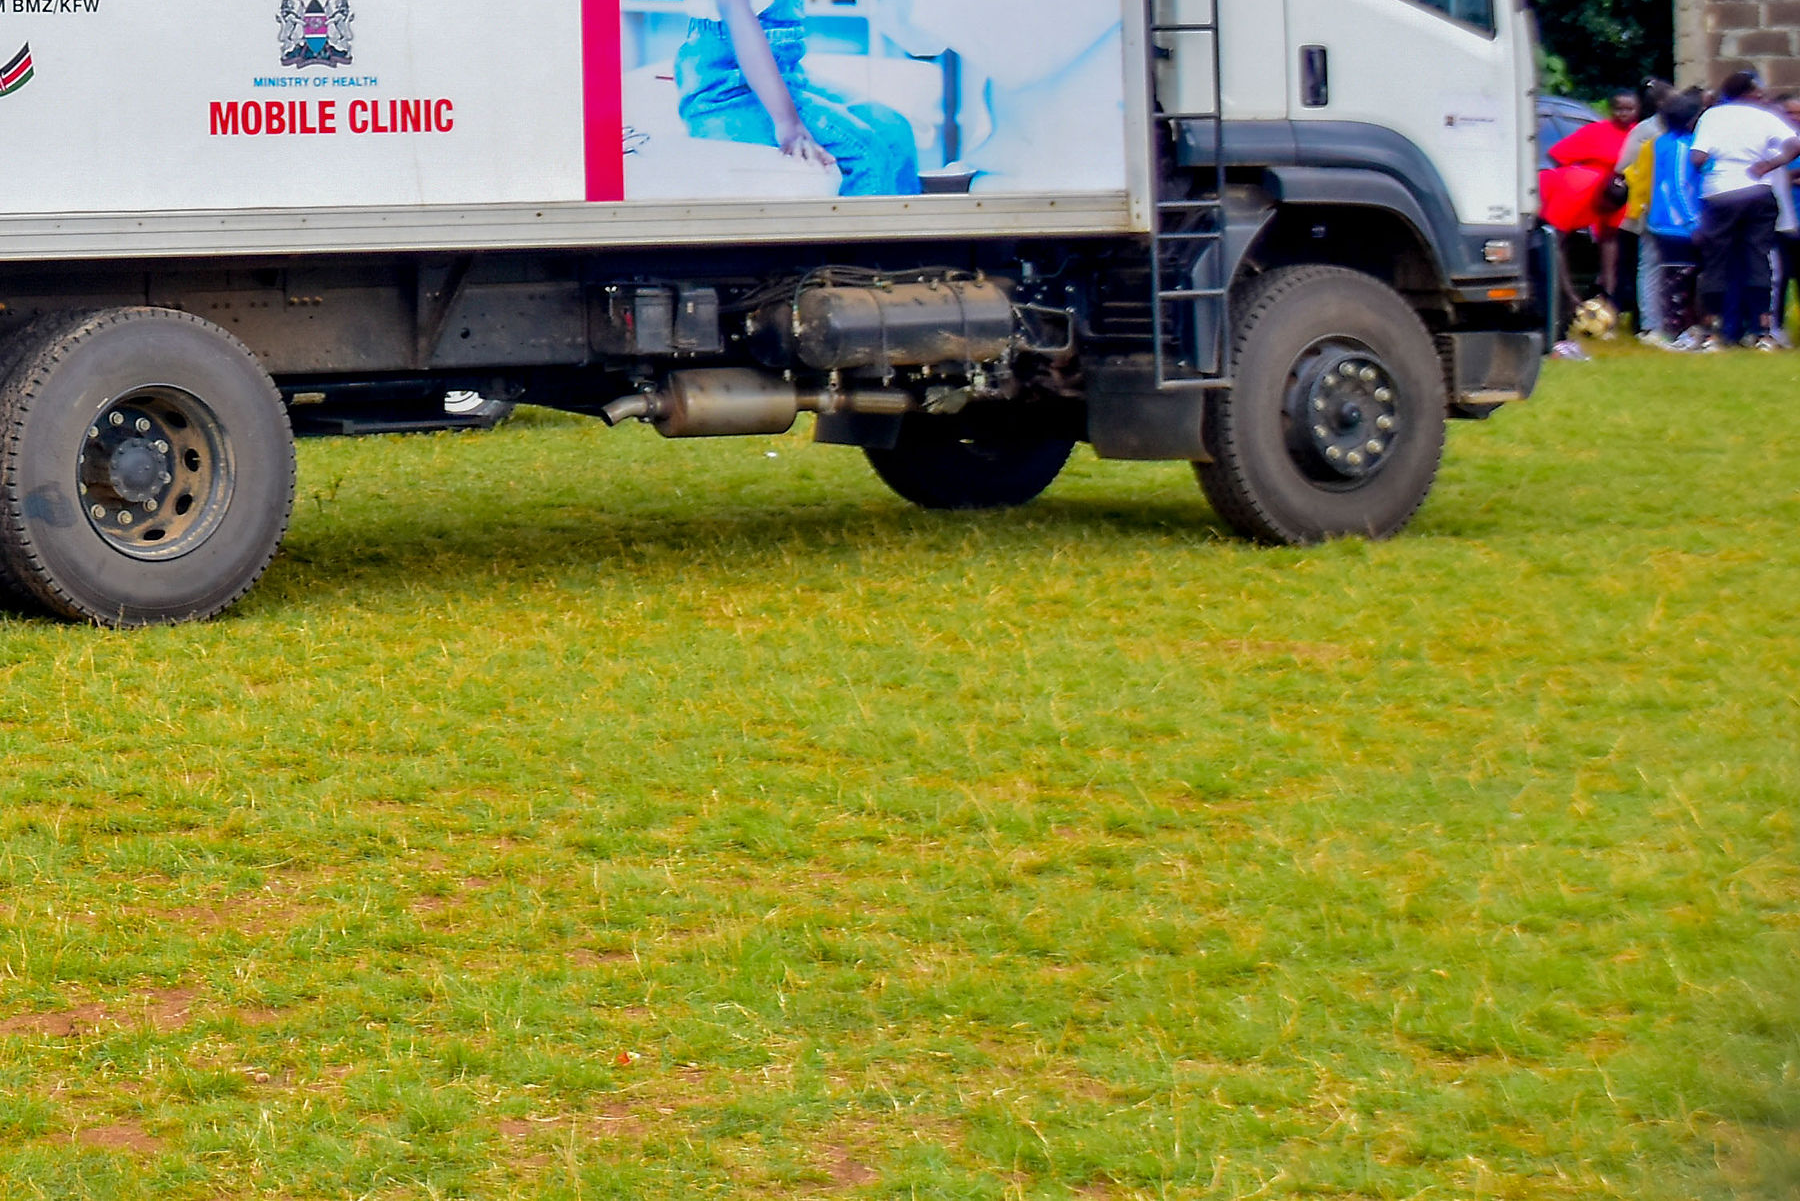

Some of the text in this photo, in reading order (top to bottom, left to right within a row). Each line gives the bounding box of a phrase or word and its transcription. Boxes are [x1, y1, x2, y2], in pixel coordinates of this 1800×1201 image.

[254, 77, 377, 87] MINISTRY OF HEALTH
[210, 99, 453, 135] MOBILE CLINIC
